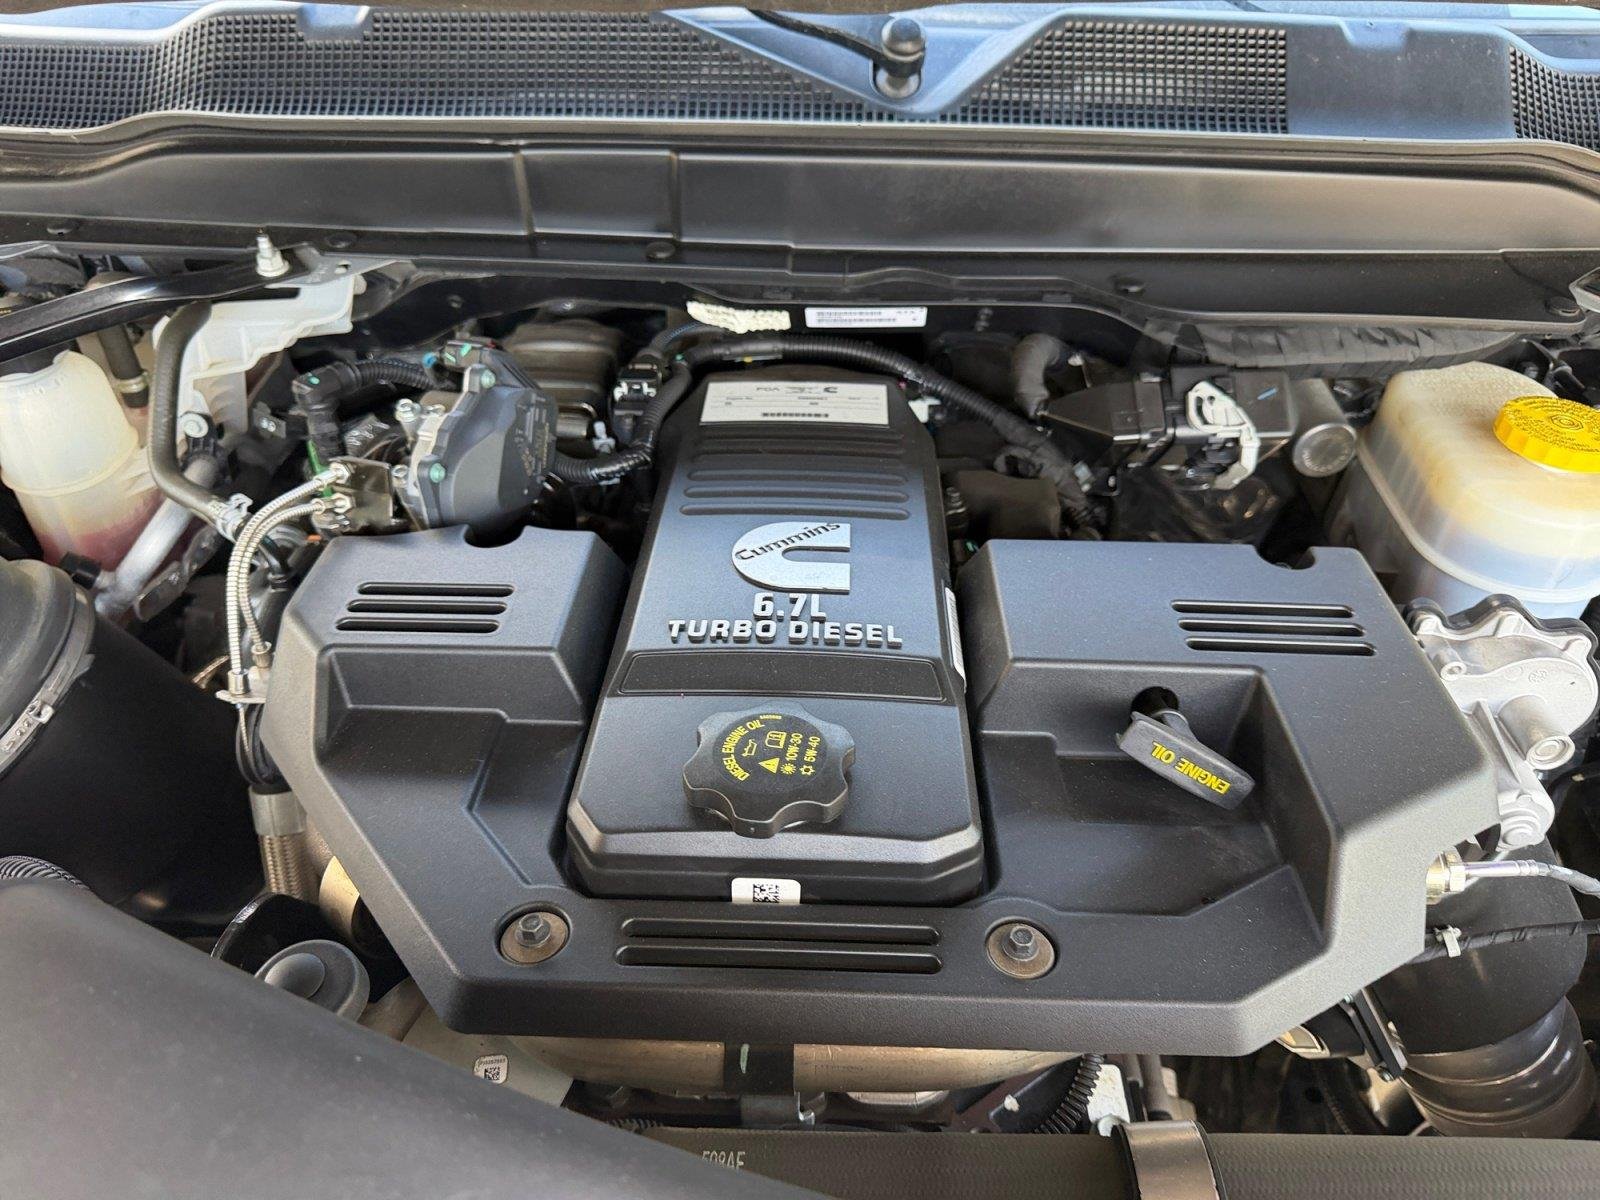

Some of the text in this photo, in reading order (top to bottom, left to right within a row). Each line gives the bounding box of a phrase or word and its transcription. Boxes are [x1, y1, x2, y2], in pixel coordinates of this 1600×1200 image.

[735, 522, 841, 561] Cummins
[752, 592, 827, 619] 6.7L
[668, 618, 903, 648] TURBO DIESEL
[721, 719, 765, 782] DIESEL ENGINE OIL
[785, 732, 804, 762] 10W-30
[803, 736, 821, 763] 5W-40
[1151, 740, 1231, 794] ENGINE OIL
